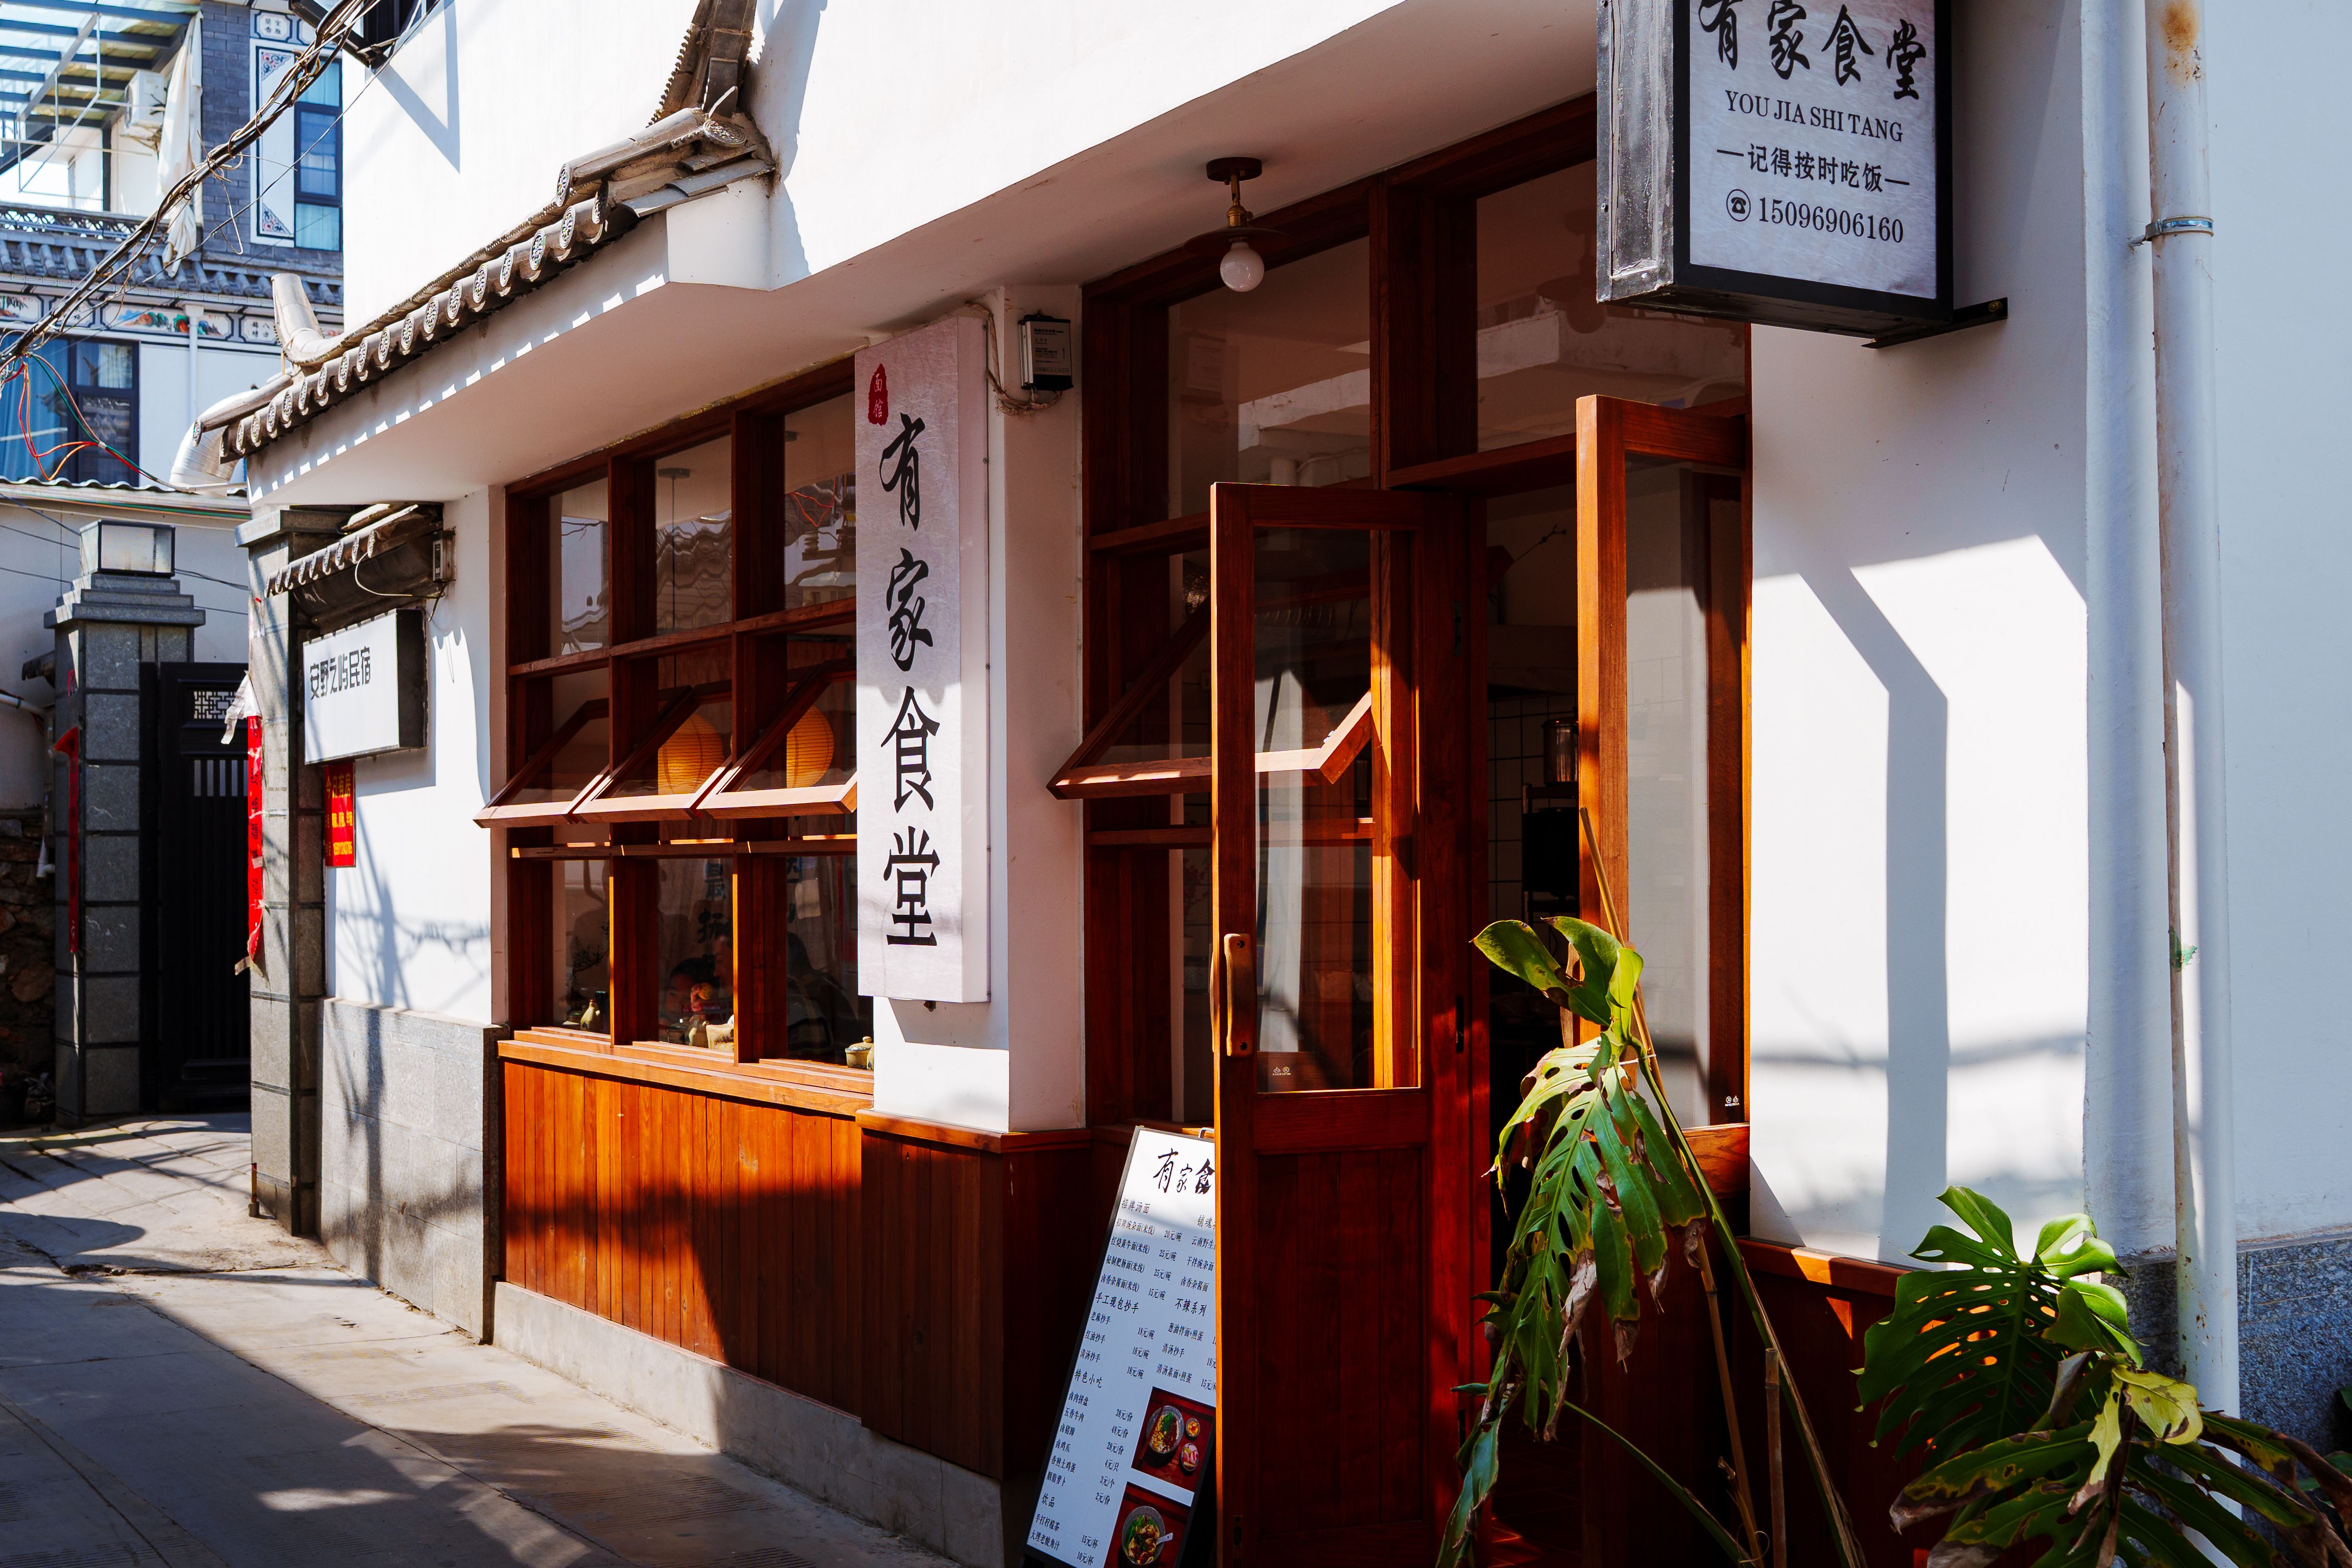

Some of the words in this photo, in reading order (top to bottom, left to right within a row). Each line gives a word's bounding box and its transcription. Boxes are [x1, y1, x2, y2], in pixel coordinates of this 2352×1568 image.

[1698, 0, 1926, 100] 有家食堂
[1725, 90, 1769, 117] YOU
[1774, 100, 1806, 125] JIA
[1810, 106, 1843, 132] SHI
[1848, 113, 1903, 142] TANG
[1758, 197, 1903, 243] 15096906160
[879, 412, 940, 946] 有家食堂
[326, 772, 351, 799] 今日有房
[1121, 1198, 1150, 1214] 招牌汤面
[1197, 1215, 1216, 1229] 销魂
[1192, 1236, 1216, 1250] 云南野生
[1096, 1292, 1139, 1313] 手工现包抄手
[1175, 1298, 1207, 1317] 不辣系列
[1074, 1368, 1102, 1388] 特色小吃
[1042, 1492, 1055, 1508] 饮品
